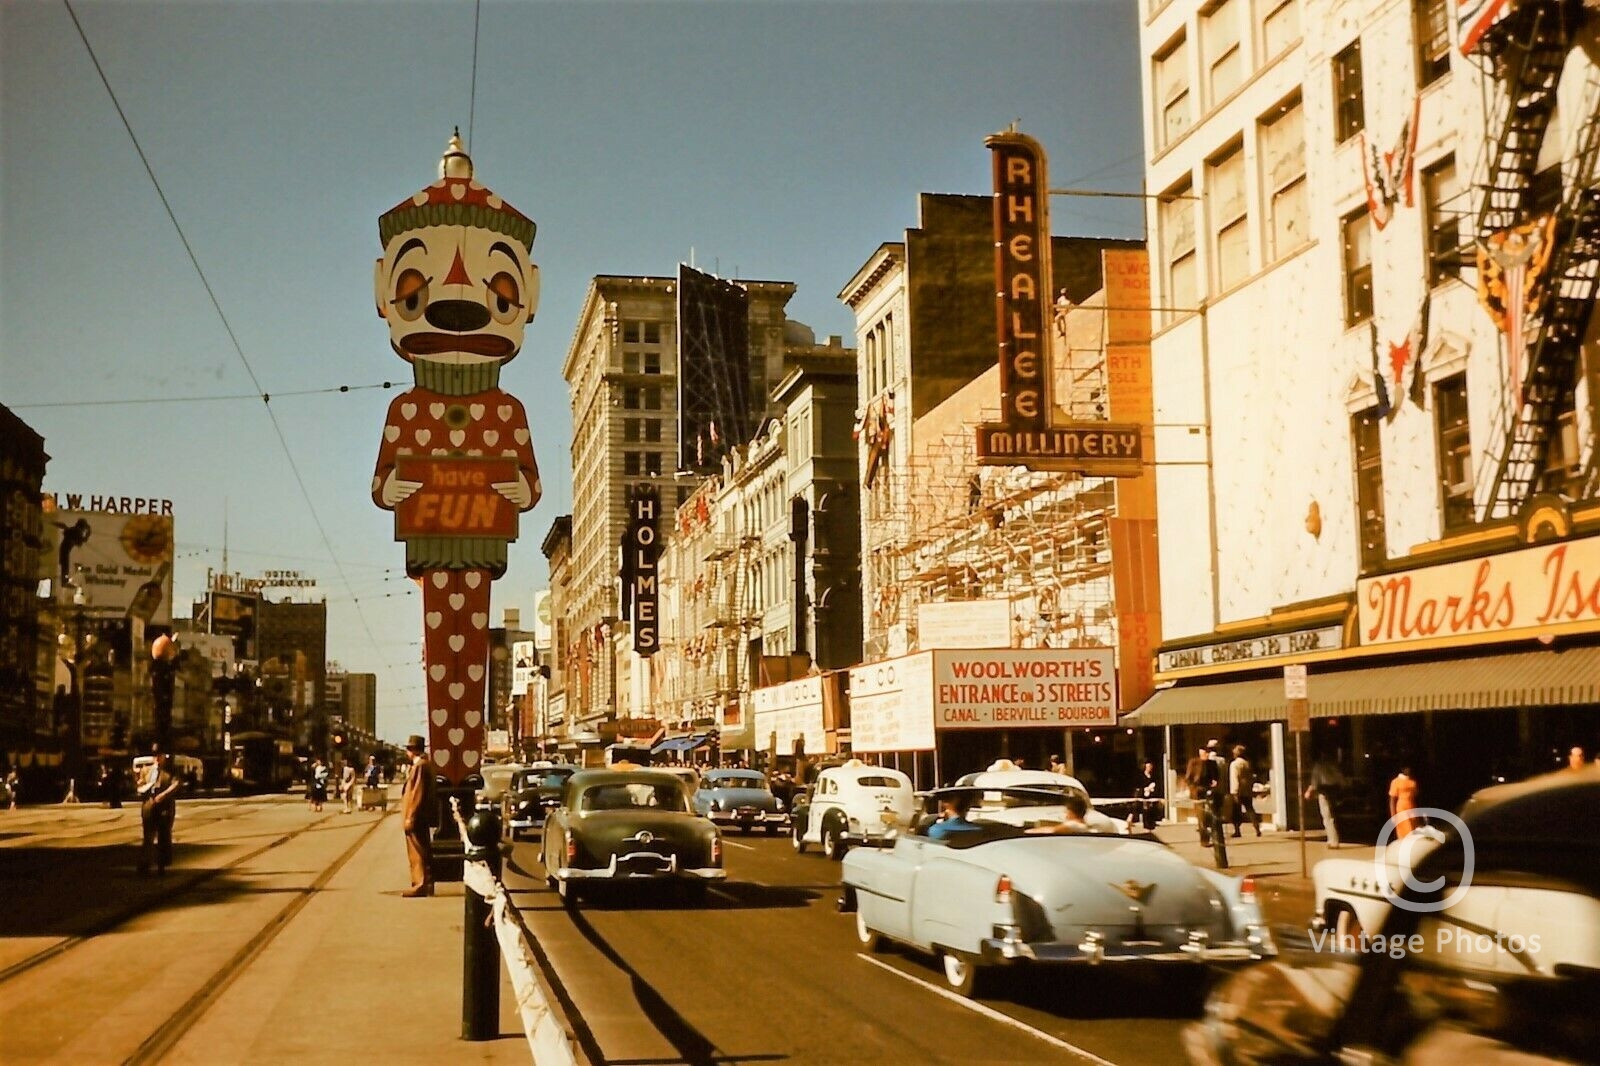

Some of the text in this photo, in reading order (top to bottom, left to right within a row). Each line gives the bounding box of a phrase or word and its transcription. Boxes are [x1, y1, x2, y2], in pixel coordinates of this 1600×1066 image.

[1006, 157, 1037, 418] RHEALEE
[990, 432, 1137, 456] MILLINERY
[432, 463, 486, 487] have
[90, 495, 173, 516] HARPER
[412, 493, 501, 529] FUN
[637, 499, 655, 648] HOLMES
[1368, 558, 1515, 642] Marks
[951, 658, 1102, 679] WOOLWORTH'S
[939, 681, 1112, 704] ENTRANCE ON 3 STREETS
[943, 705, 1110, 722] CANAL IBERVILLE BOURBON
